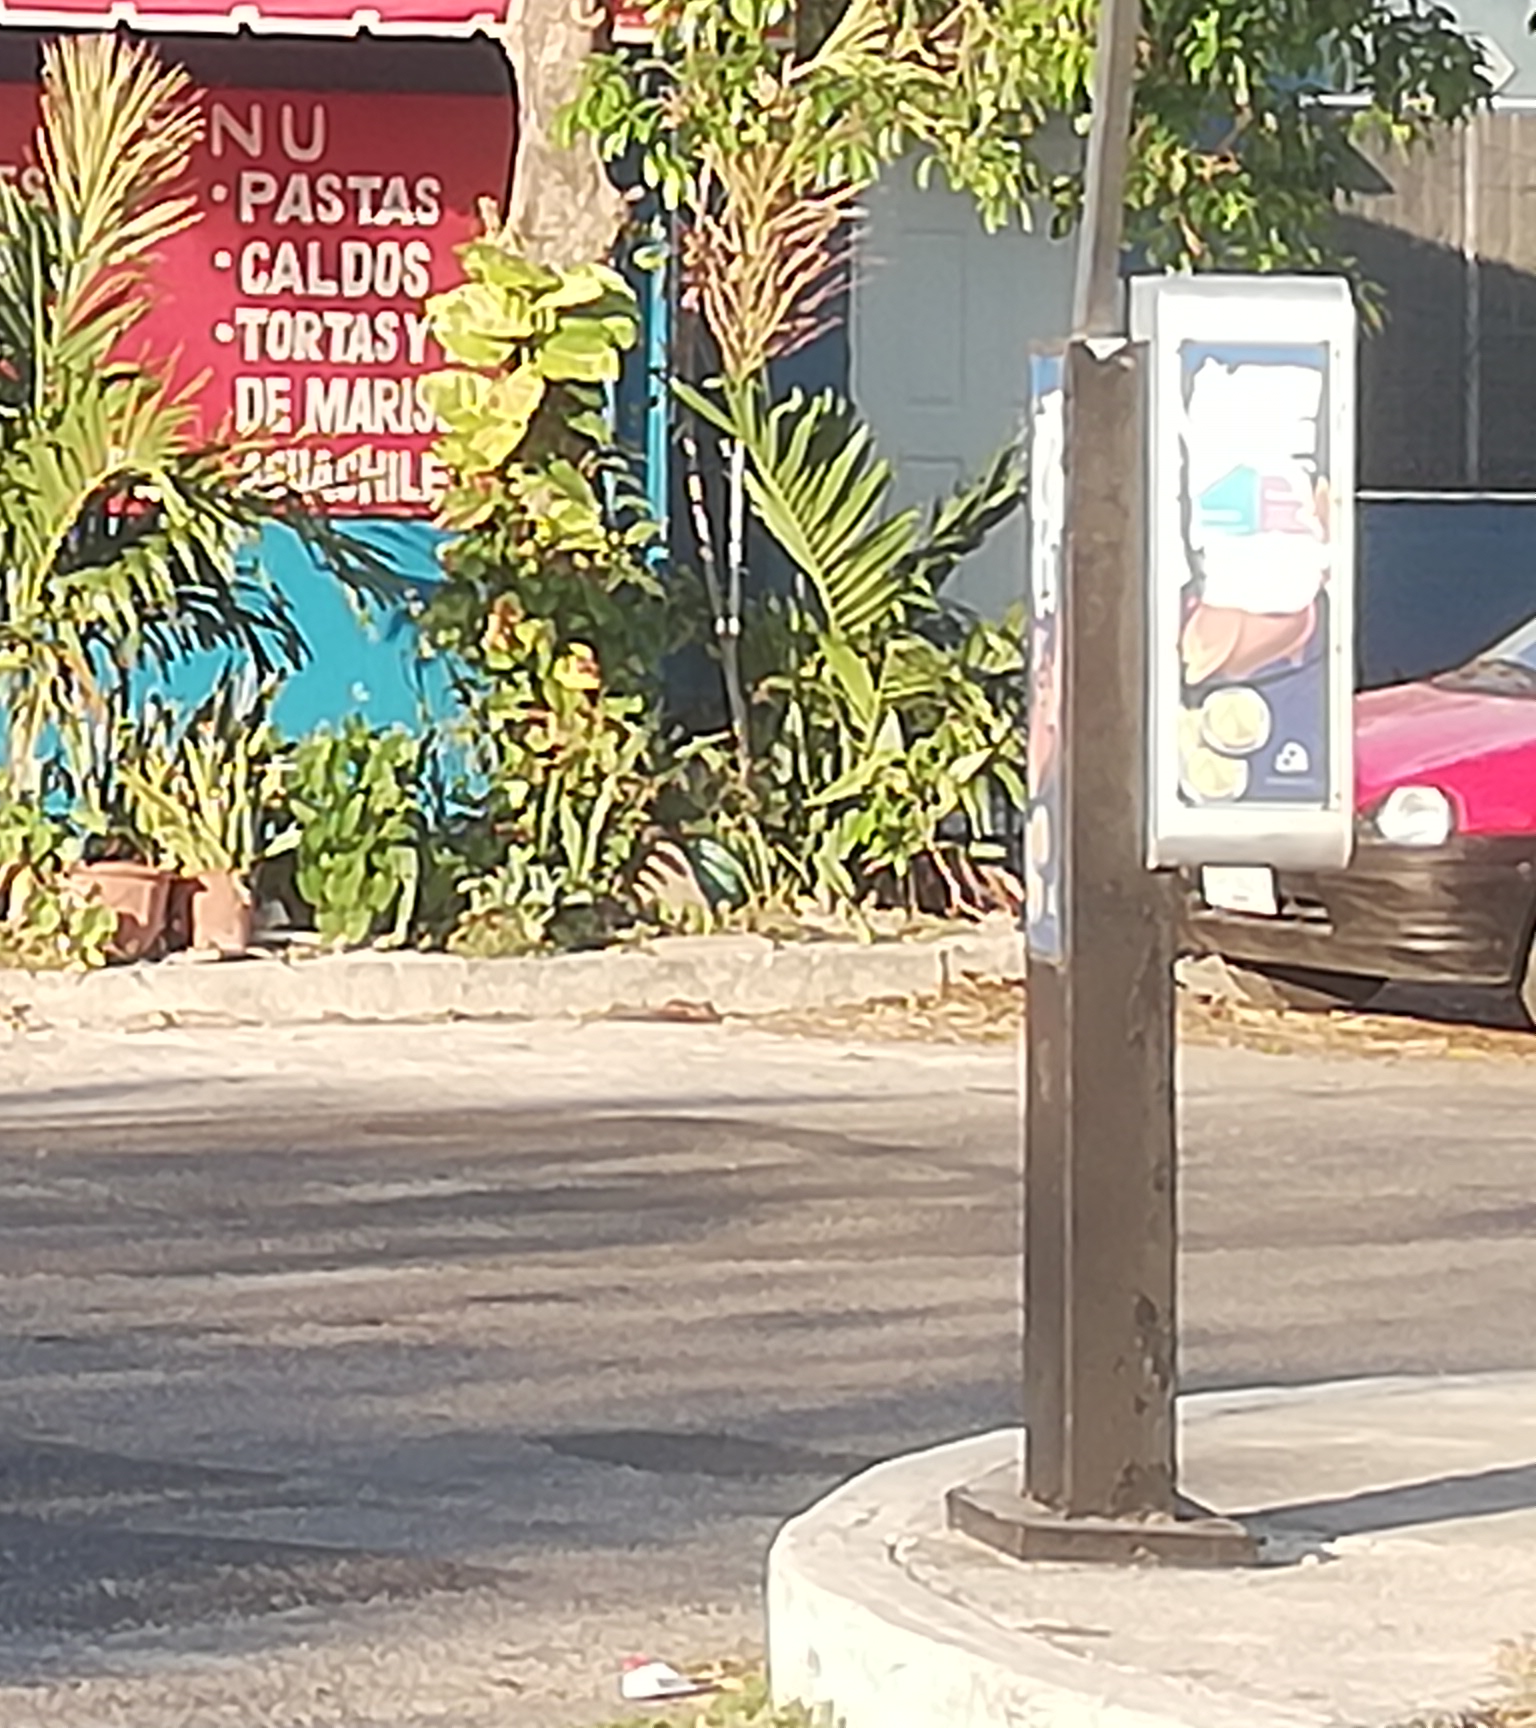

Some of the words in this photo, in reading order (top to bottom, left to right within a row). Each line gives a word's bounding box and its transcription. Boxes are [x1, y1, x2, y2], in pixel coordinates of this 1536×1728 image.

[240, 171, 441, 226] PASTAS
[241, 241, 432, 298] CALDOS
[235, 307, 399, 363] TORTAS
[235, 377, 292, 434] DE
[305, 377, 454, 434] MARIS
